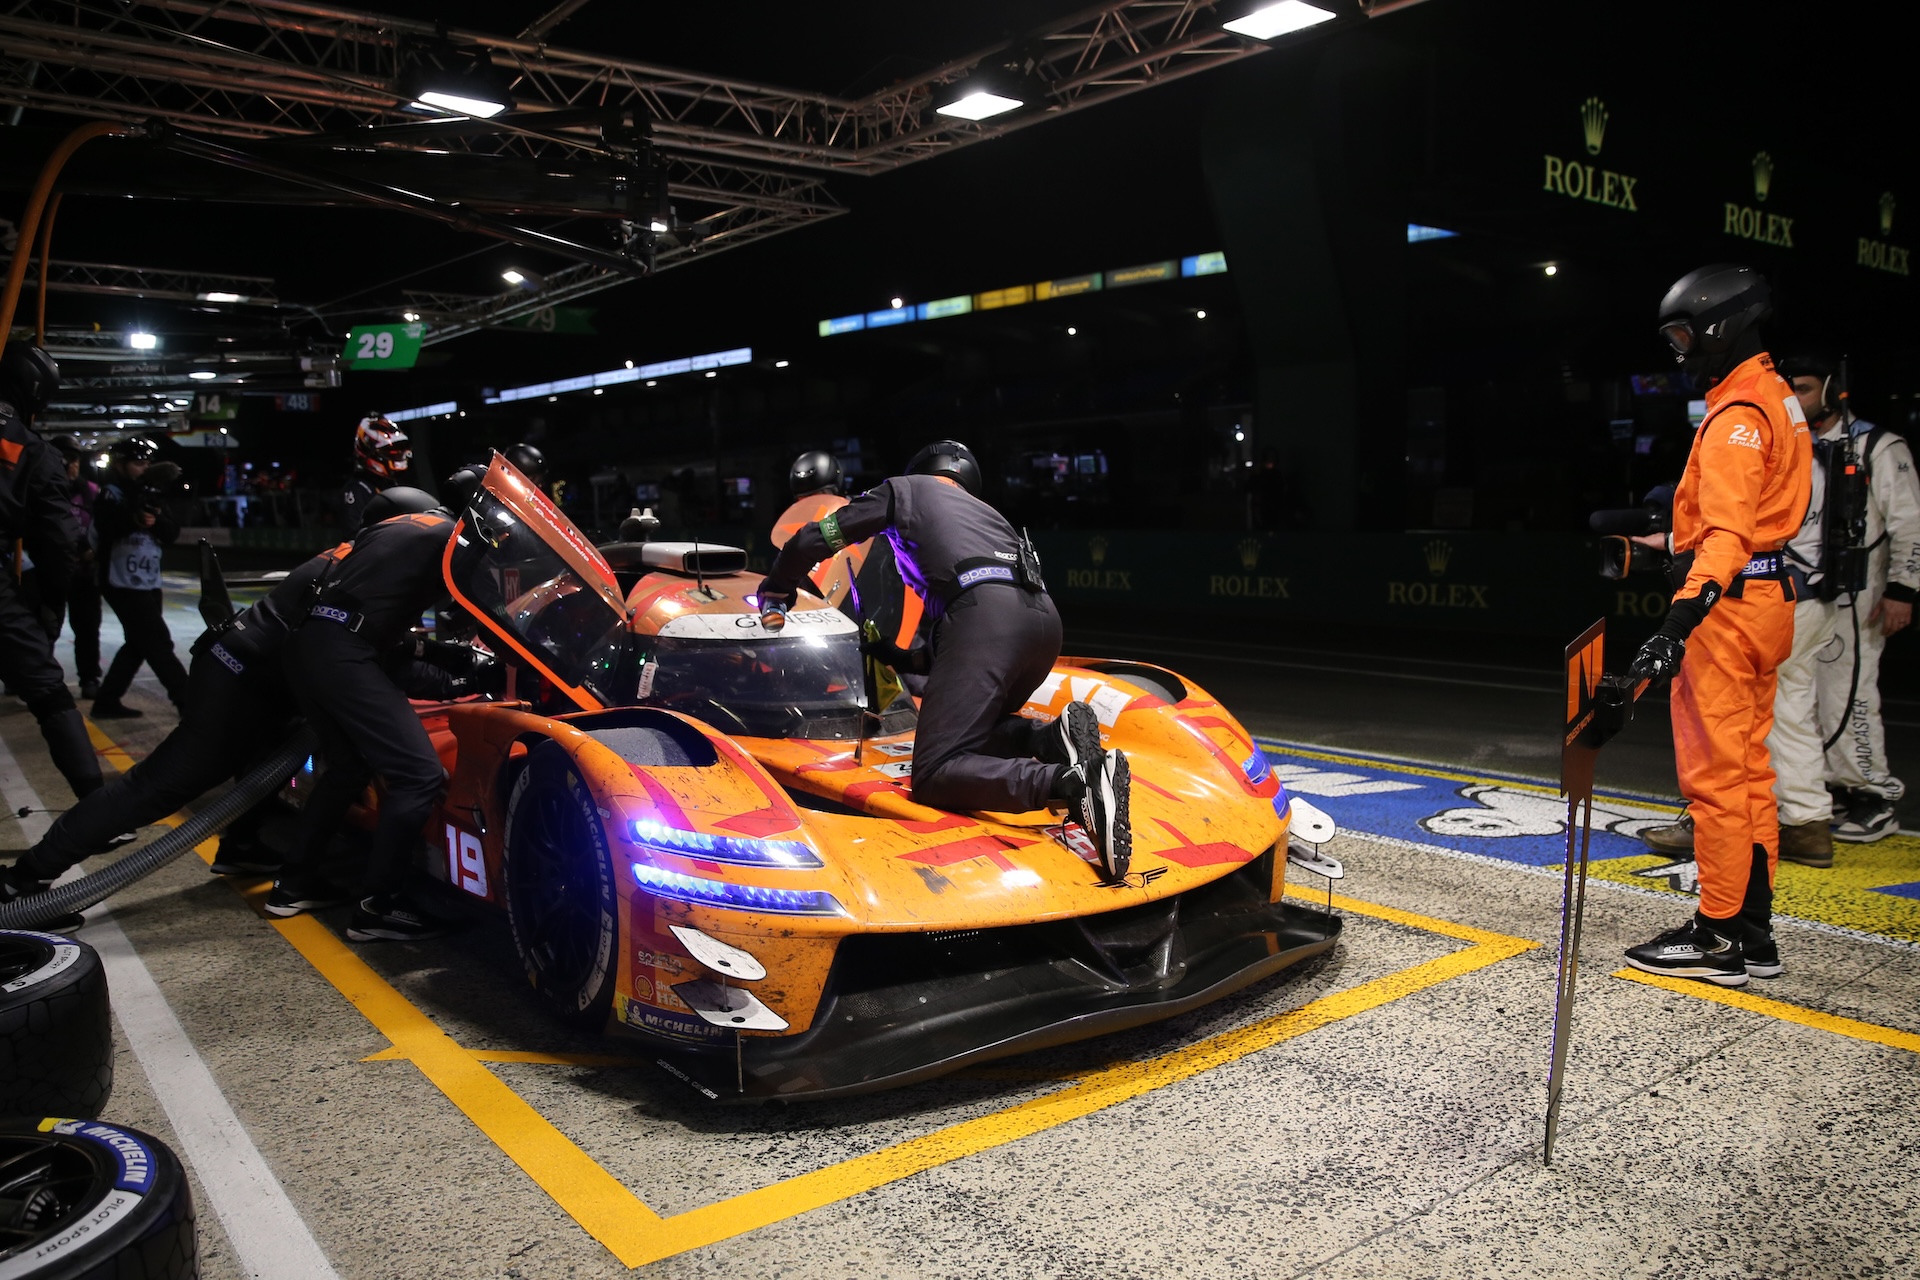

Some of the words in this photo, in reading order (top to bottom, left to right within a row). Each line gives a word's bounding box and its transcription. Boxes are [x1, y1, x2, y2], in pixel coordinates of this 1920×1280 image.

[1544, 155, 1638, 211] ROLEX
[1724, 202, 1794, 248] ROLEX
[1857, 237, 1910, 276] ROLEX
[357, 332, 394, 359] 29
[199, 394, 221, 414] 14
[1737, 440, 1761, 450] MANS
[960, 566, 1012, 586] sparco
[1066, 568, 1132, 591] ROLEX
[1209, 575, 1290, 598] ROLEX
[1387, 581, 1489, 609] ROLEX
[311, 604, 349, 623] parco
[210, 642, 245, 675] sparco
[1020, 706, 1052, 722] GENESIS
[446, 823, 488, 898] 19
[579, 801, 610, 901] MICHELIN
[1663, 944, 1695, 954] sparco
[645, 1013, 724, 1037] MICHELIN
[82, 1126, 149, 1184] MICHELIN
[92, 1197, 126, 1226] PILOT
[34, 1226, 90, 1260] SPORT
